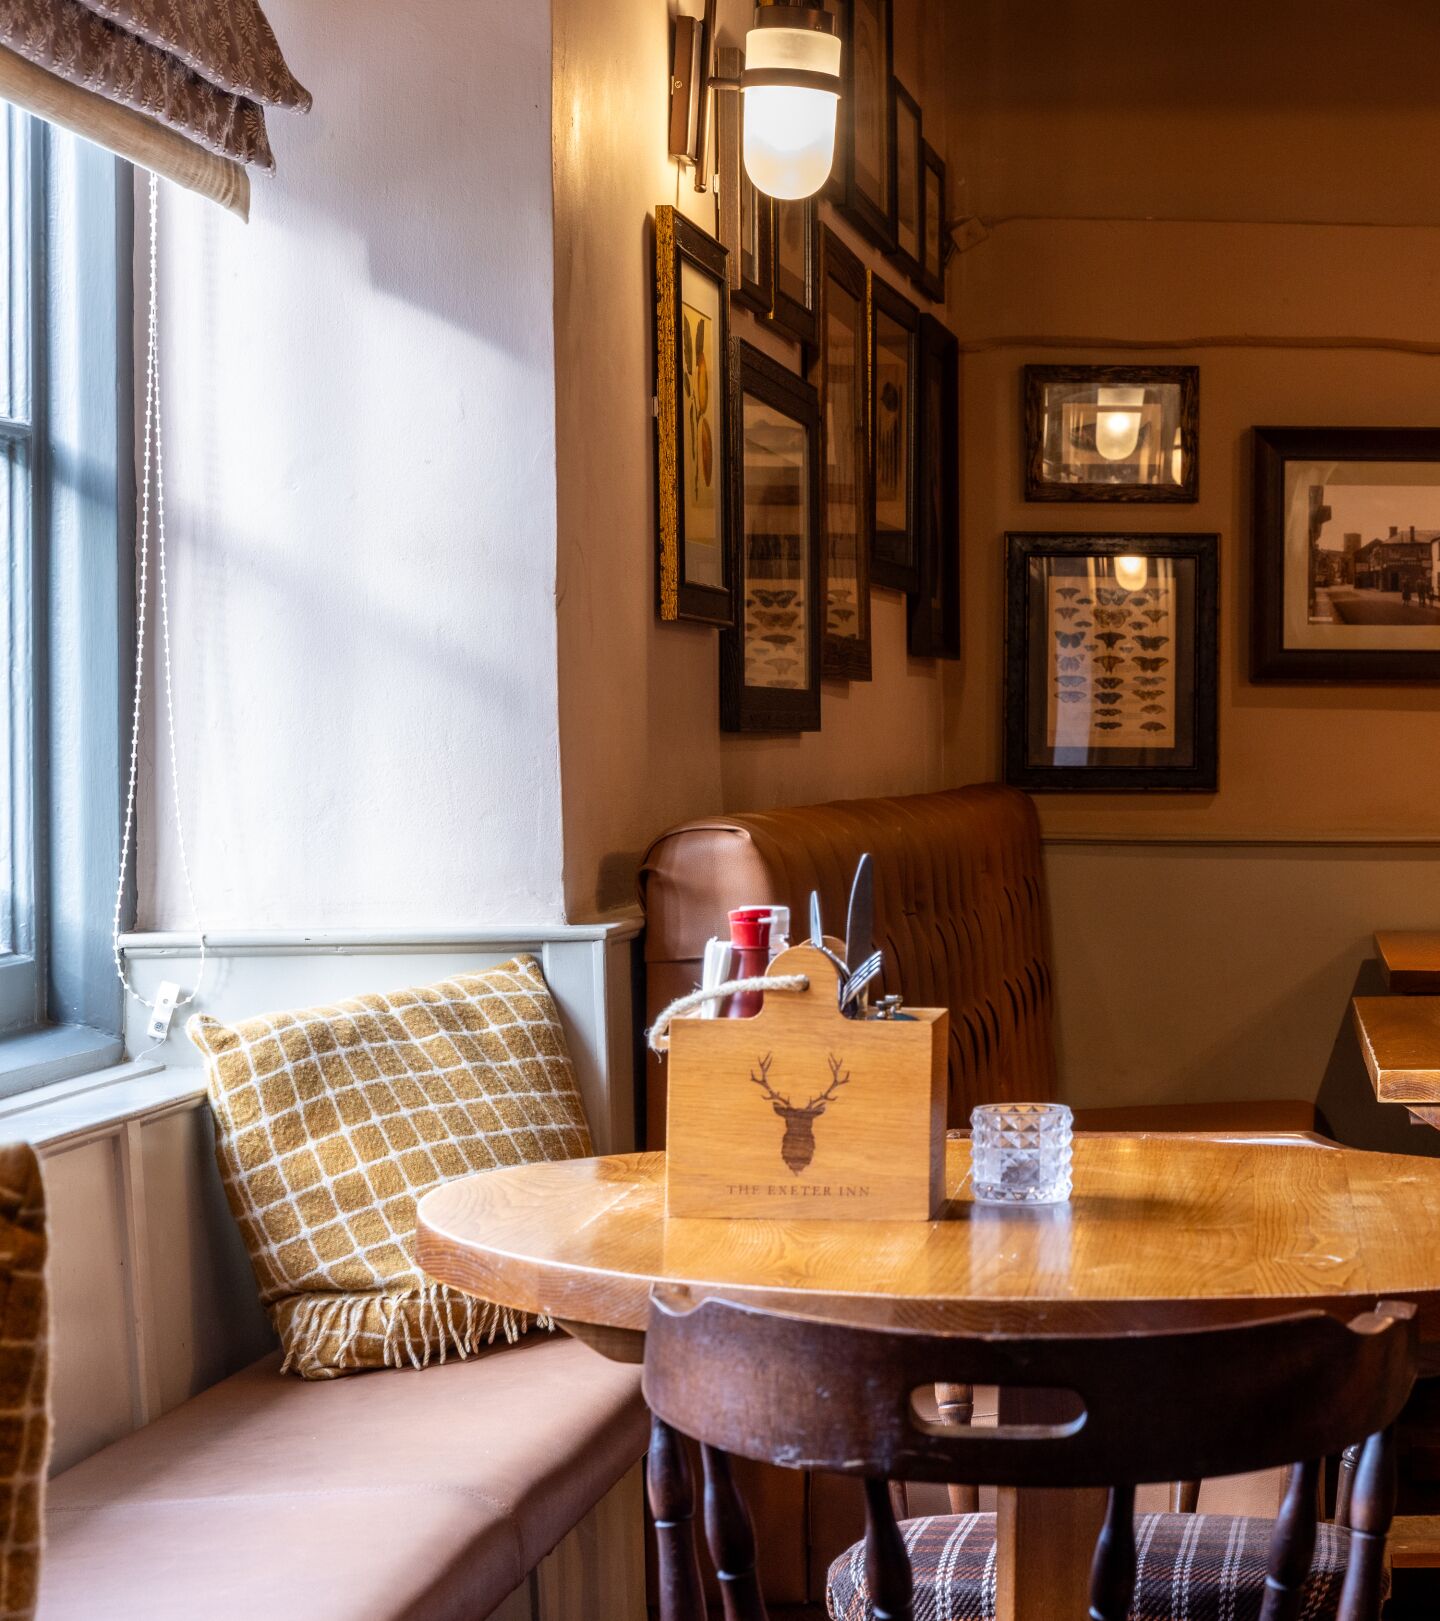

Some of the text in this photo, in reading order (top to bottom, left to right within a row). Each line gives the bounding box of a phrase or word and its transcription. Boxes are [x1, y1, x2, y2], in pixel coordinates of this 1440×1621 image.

[726, 1184, 871, 1197] THE EXETER INN
